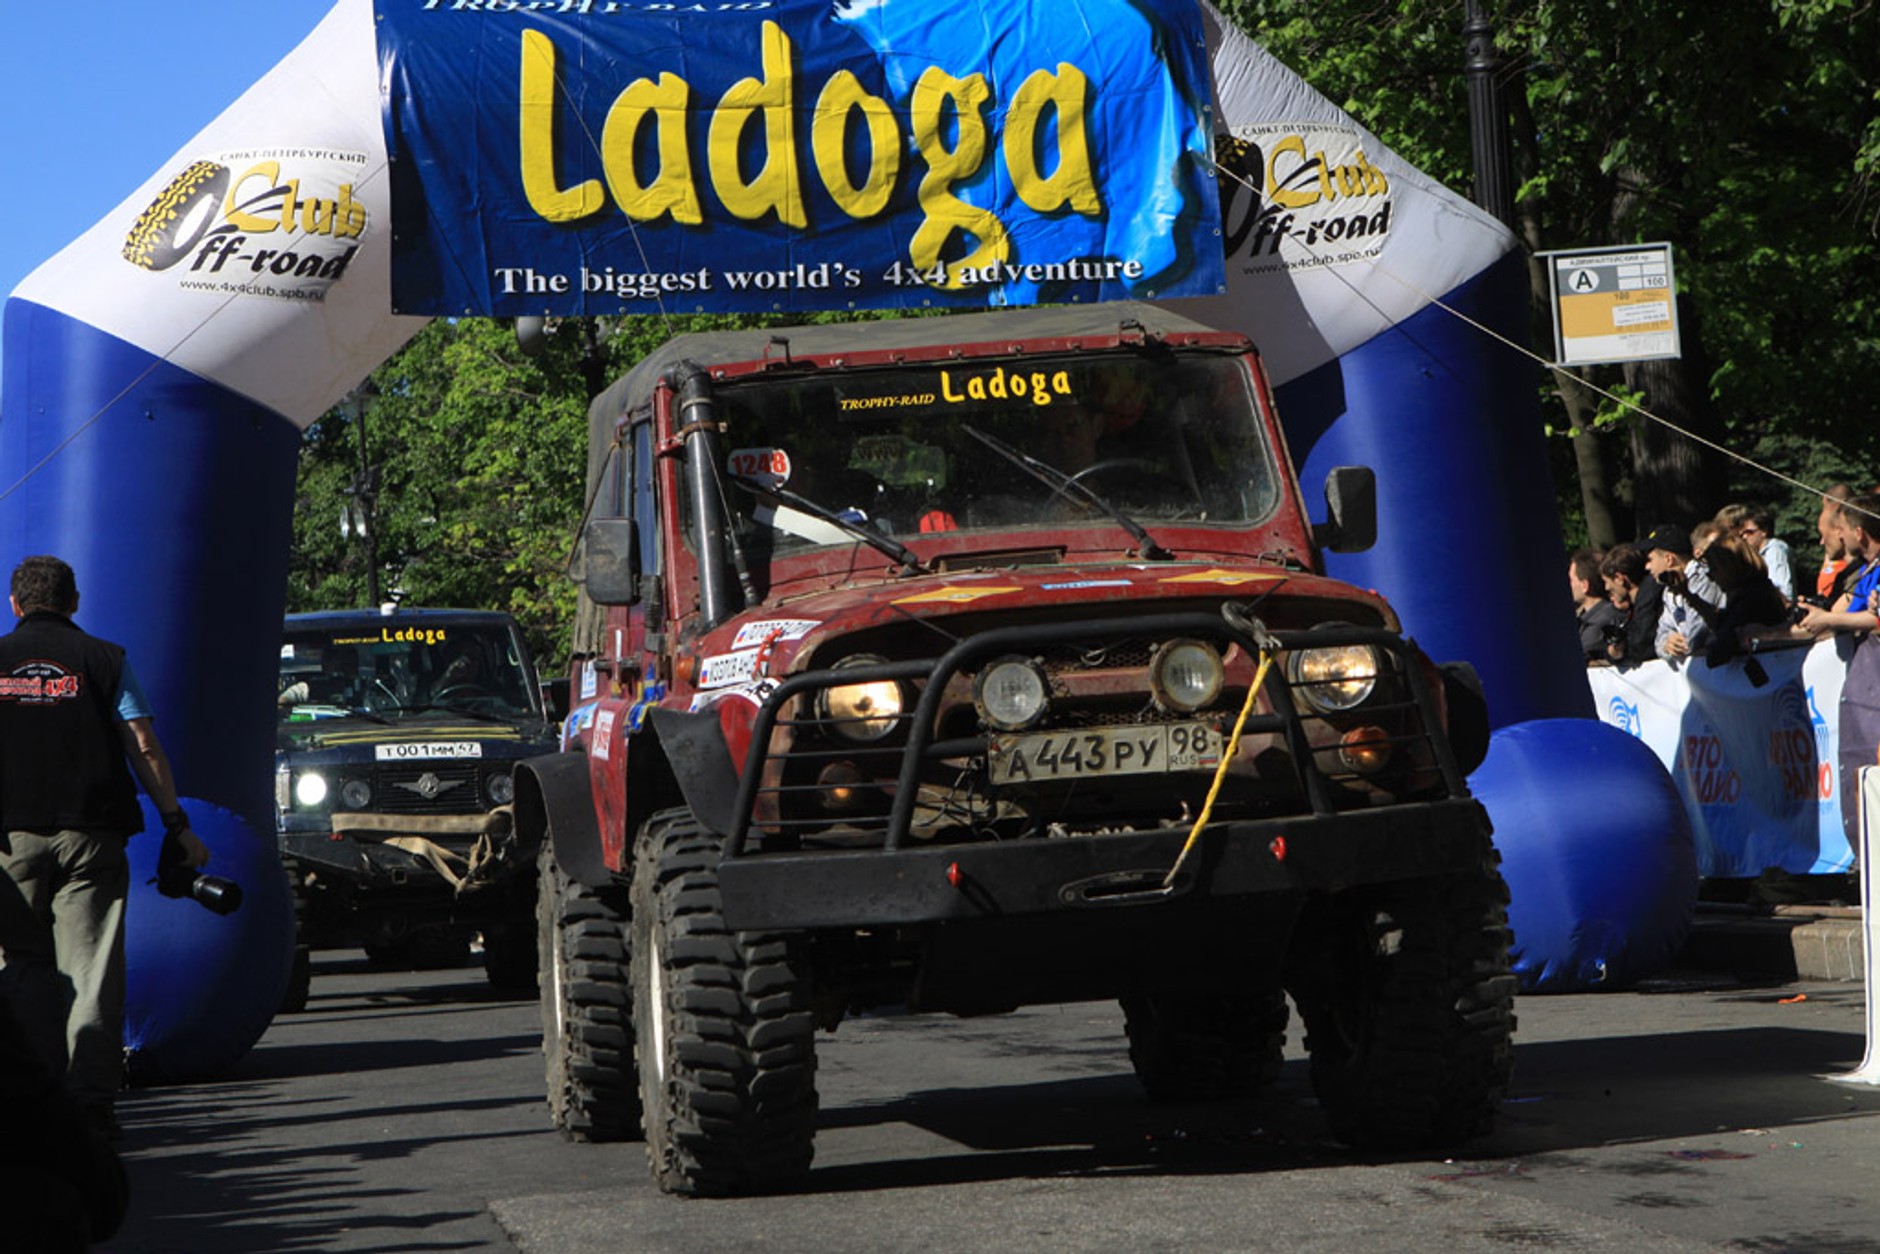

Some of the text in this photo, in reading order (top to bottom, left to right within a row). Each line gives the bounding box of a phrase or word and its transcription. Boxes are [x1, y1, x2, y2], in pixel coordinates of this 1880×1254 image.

[518, 20, 1101, 291] Ladoga
[1267, 135, 1389, 209] Club
[224, 161, 367, 239] Club
[180, 280, 324, 300] www.4x4club.spb.ru
[495, 268, 570, 293] The
[581, 265, 712, 299] biggest
[883, 260, 946, 286] 4x4
[960, 258, 1142, 285] adventure
[1575, 271, 1593, 290] А
[1647, 277, 1665, 286] 100
[840, 367, 1072, 411] TROPHY-RAID Ladoga
[731, 452, 787, 475] 1248
[382, 627, 446, 645] Ladoga
[1171, 727, 1208, 754] 98
[1170, 753, 1197, 765] RUS
